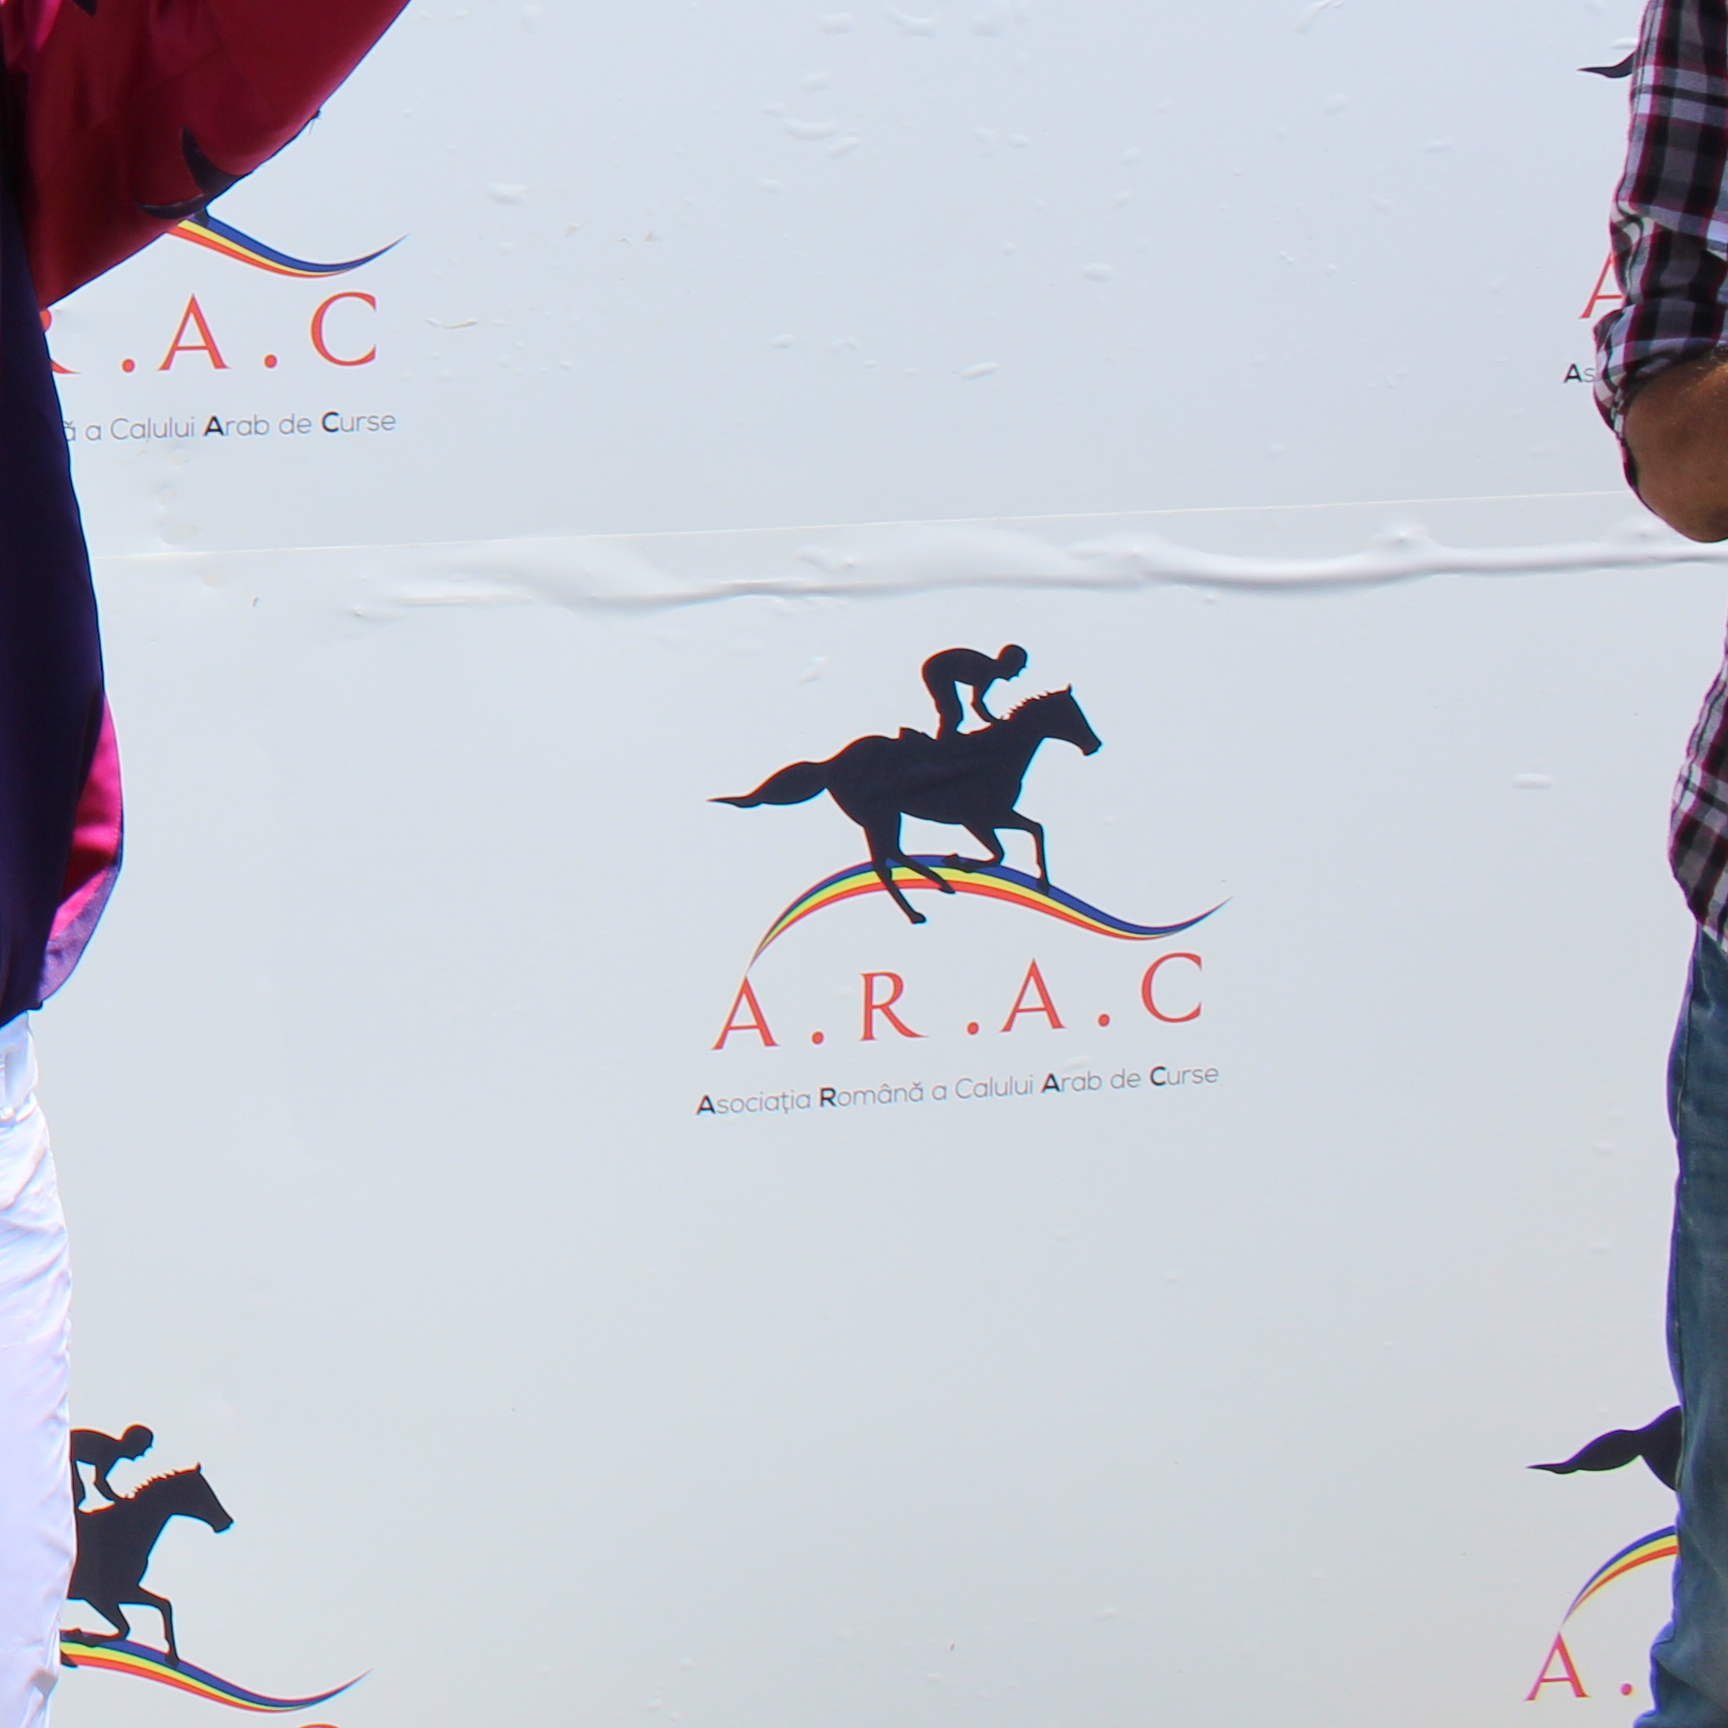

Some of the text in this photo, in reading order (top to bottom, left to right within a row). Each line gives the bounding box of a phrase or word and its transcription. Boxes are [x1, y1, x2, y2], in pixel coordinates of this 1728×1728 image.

[85, 424, 102, 441] a
[110, 416, 195, 441] Calului
[202, 414, 270, 437] Arab
[279, 413, 312, 435] de
[321, 410, 398, 434] Curse
[694, 1065, 1220, 1117] Asociația Română a Calului Arab de Curse
